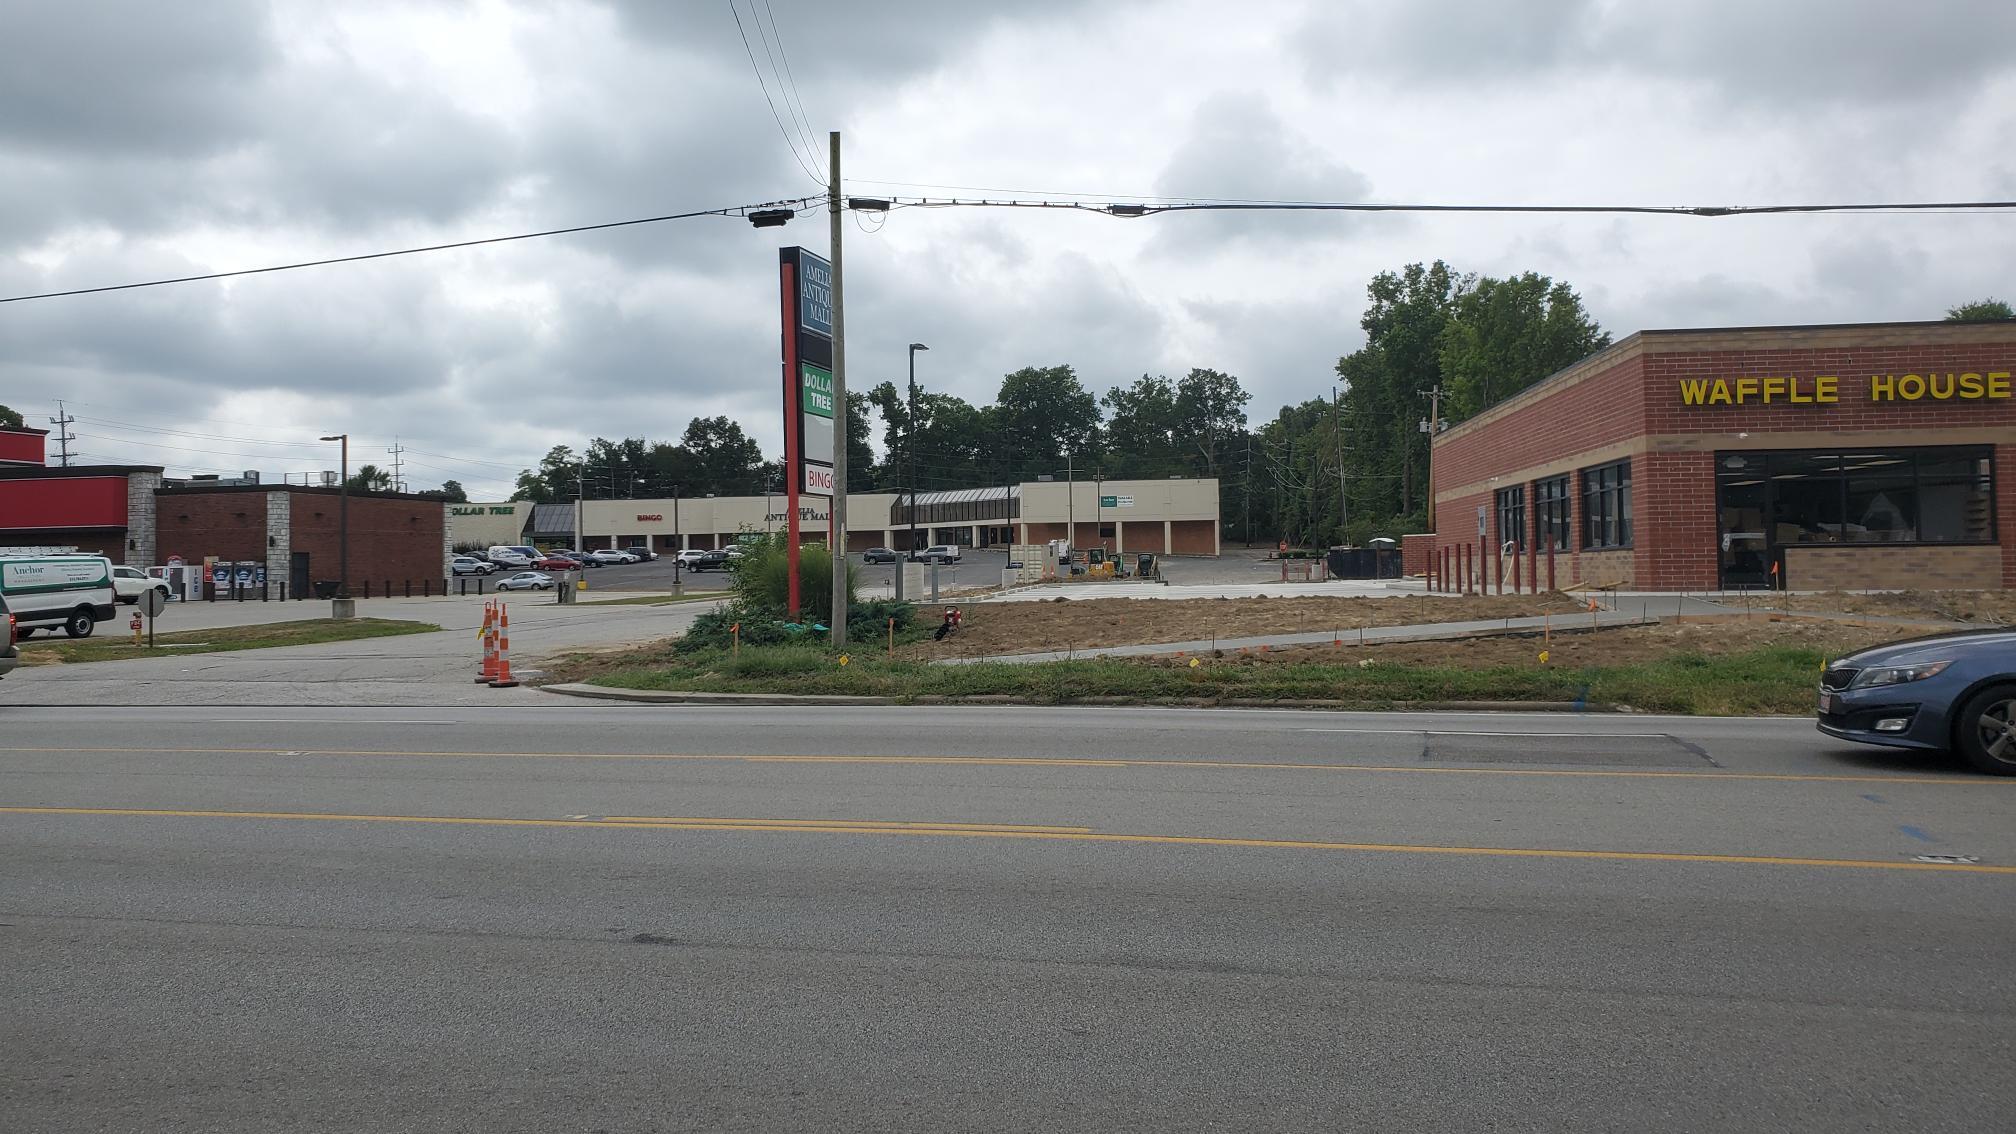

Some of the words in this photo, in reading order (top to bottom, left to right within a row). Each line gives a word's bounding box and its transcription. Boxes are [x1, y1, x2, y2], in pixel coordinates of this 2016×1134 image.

[803, 281, 832, 308] ANTIQU
[804, 372, 833, 394] DOLLA
[1680, 376, 1839, 405] WAFFLE
[1871, 372, 2012, 401] HOUSE
[811, 392, 832, 411] TREE
[452, 507, 485, 516] OLLAR
[489, 506, 515, 515] TREE
[764, 513, 809, 522] ANTIE
[810, 513, 831, 521] MAL
[14, 565, 45, 575] Anchor
